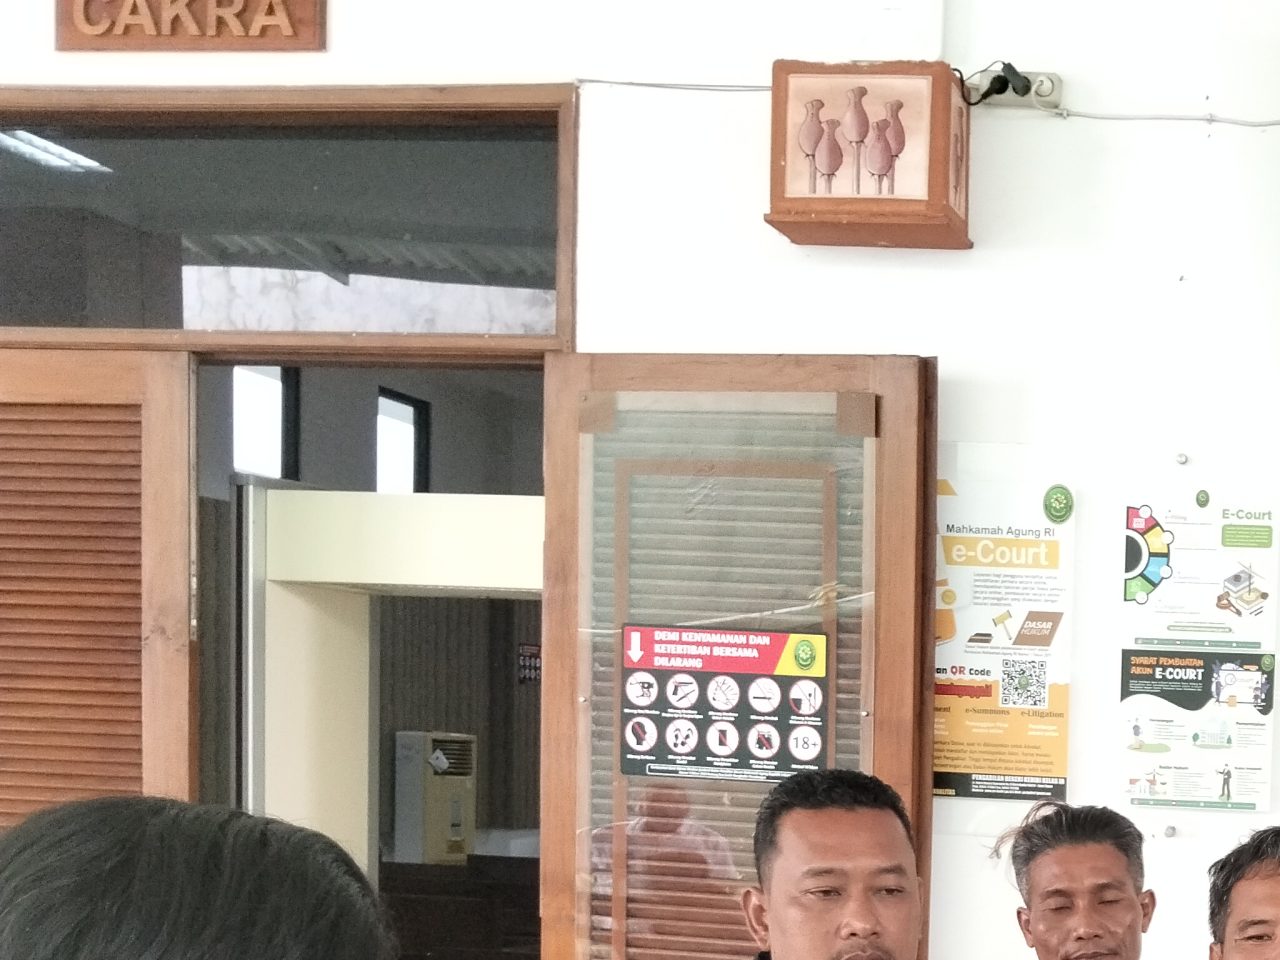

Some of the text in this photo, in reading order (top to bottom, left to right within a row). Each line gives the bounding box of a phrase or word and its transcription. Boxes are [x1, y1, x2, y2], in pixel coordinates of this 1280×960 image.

[73, 0, 295, 36] CAKRA
[1222, 509, 1272, 520] E-Court
[946, 524, 1055, 538] Mahkamah Agung RI
[952, 539, 1048, 565] e-Court
[1024, 621, 1052, 629] DASAR
[654, 631, 770, 645] DEMI KENYAMANAN DAN
[654, 644, 758, 658] KETERTIBAN BERSAMA
[654, 657, 702, 668] DILARANG
[1131, 656, 1203, 666] SYARAT PEMBUATAN
[951, 666, 966, 675] QR
[969, 667, 991, 676] Code
[1155, 667, 1204, 680] E-COURT
[1021, 709, 1064, 718] e-Litigation
[793, 736, 818, 750] 18+
